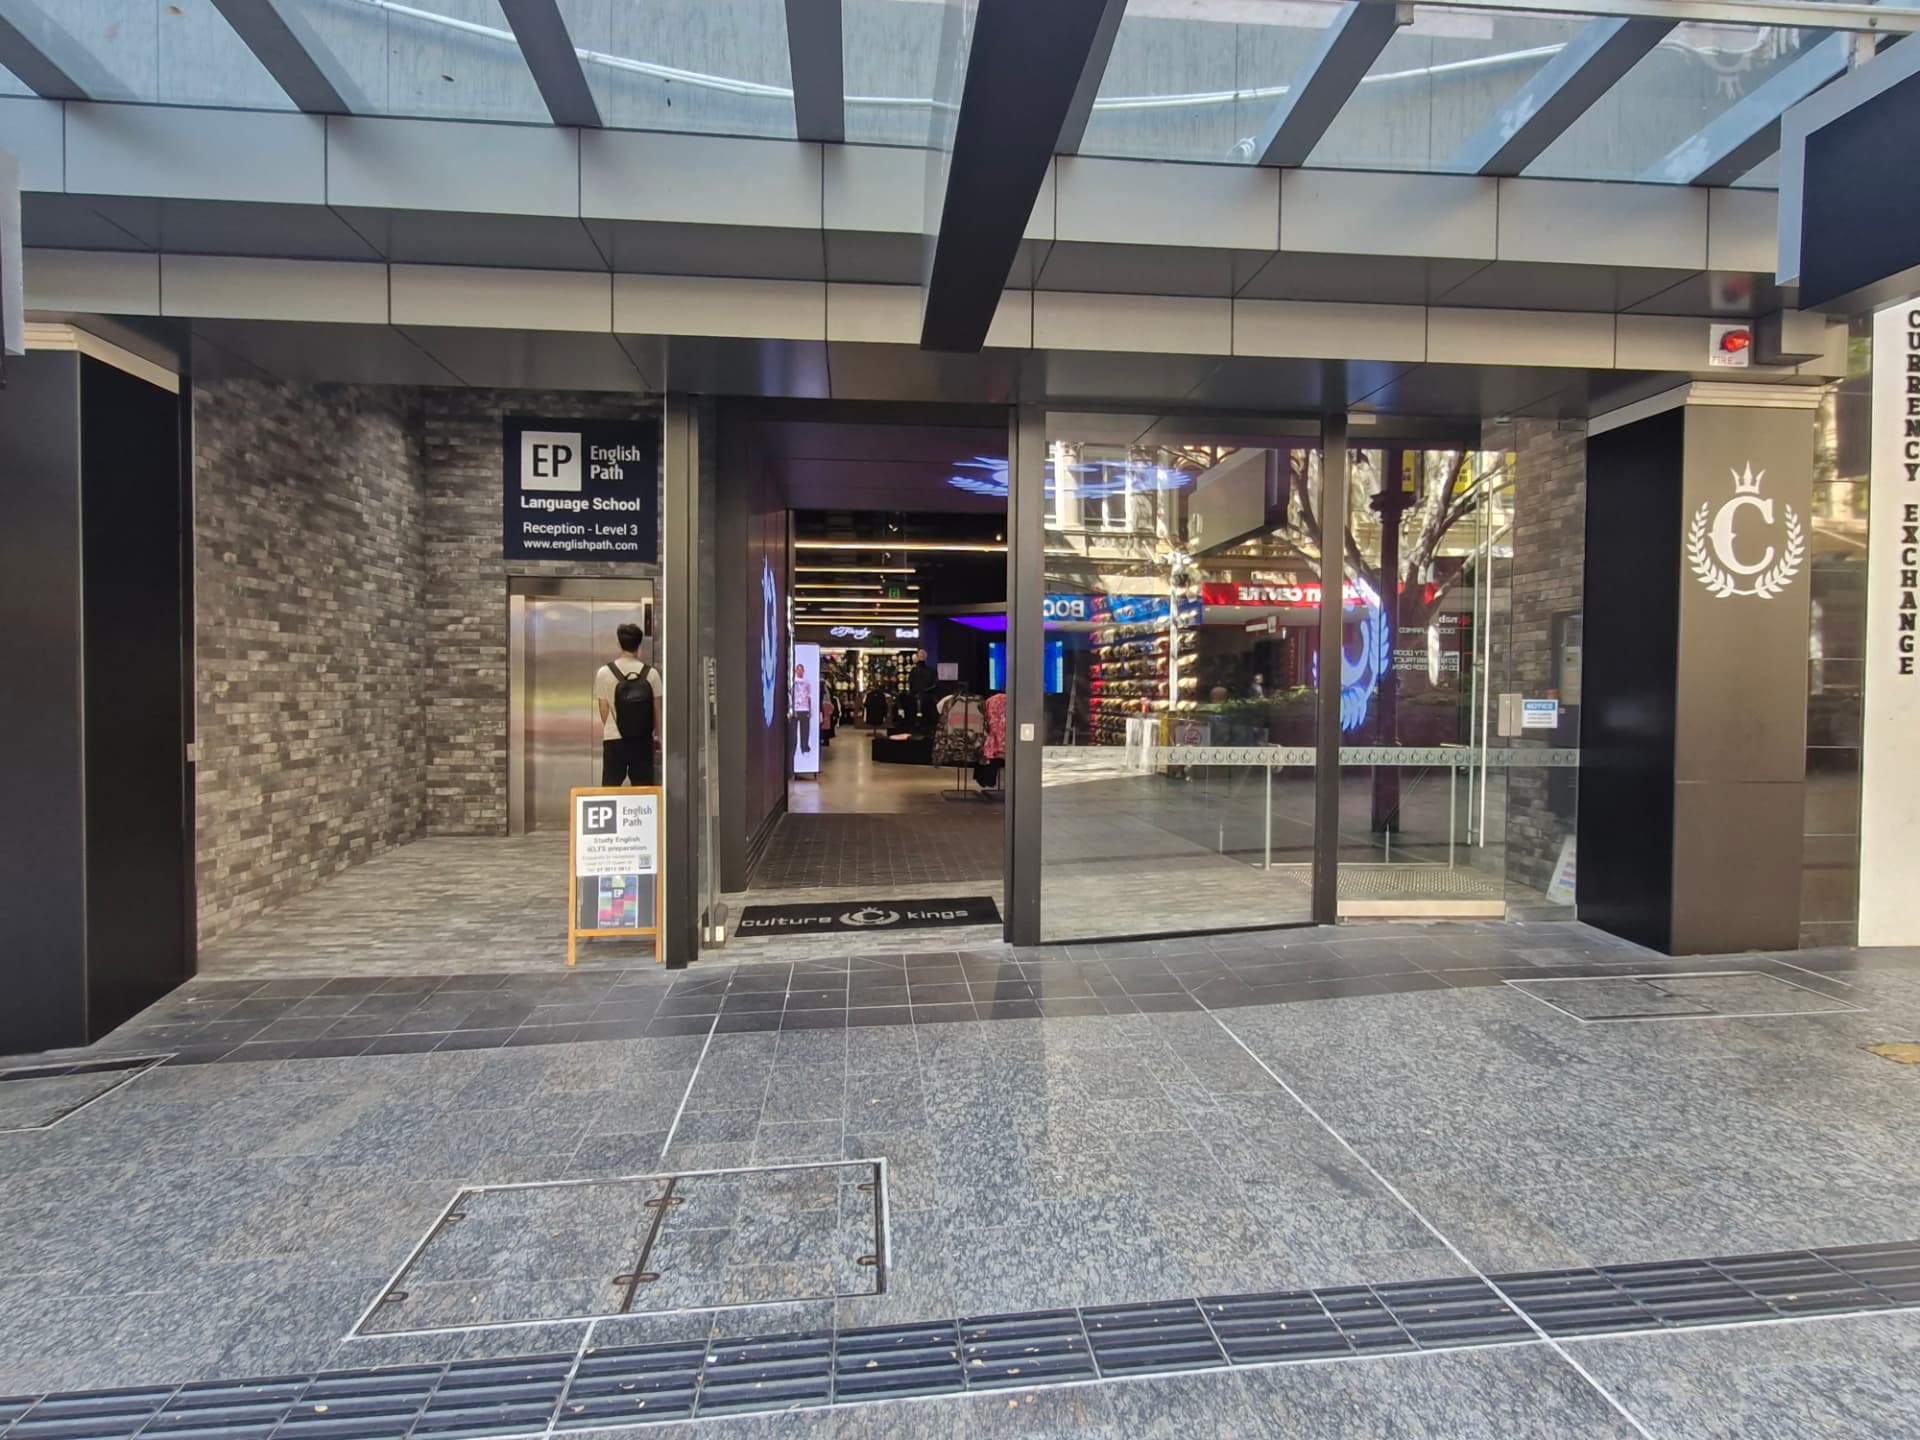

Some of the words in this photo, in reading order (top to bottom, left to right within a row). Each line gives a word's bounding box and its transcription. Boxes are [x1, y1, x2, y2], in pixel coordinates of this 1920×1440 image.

[532, 444, 572, 477] EP
[590, 445, 640, 464] English
[590, 465, 623, 480] Path
[521, 496, 589, 512] Language
[593, 498, 640, 511] School
[523, 522, 584, 537] Reception
[595, 524, 627, 535] Level
[630, 525, 638, 535] 3
[523, 539, 638, 552] www.englishpath.com
[1898, 504, 1919, 675] EXCHANGE
[1526, 702, 1553, 711] NOTICE
[588, 806, 612, 829] EP
[622, 805, 652, 817] English
[622, 818, 642, 827] Path
[593, 837, 613, 845] Study
[616, 836, 640, 844] English
[608, 845, 647, 853] preparation
[741, 917, 832, 927] culture
[907, 909, 969, 920] kings
